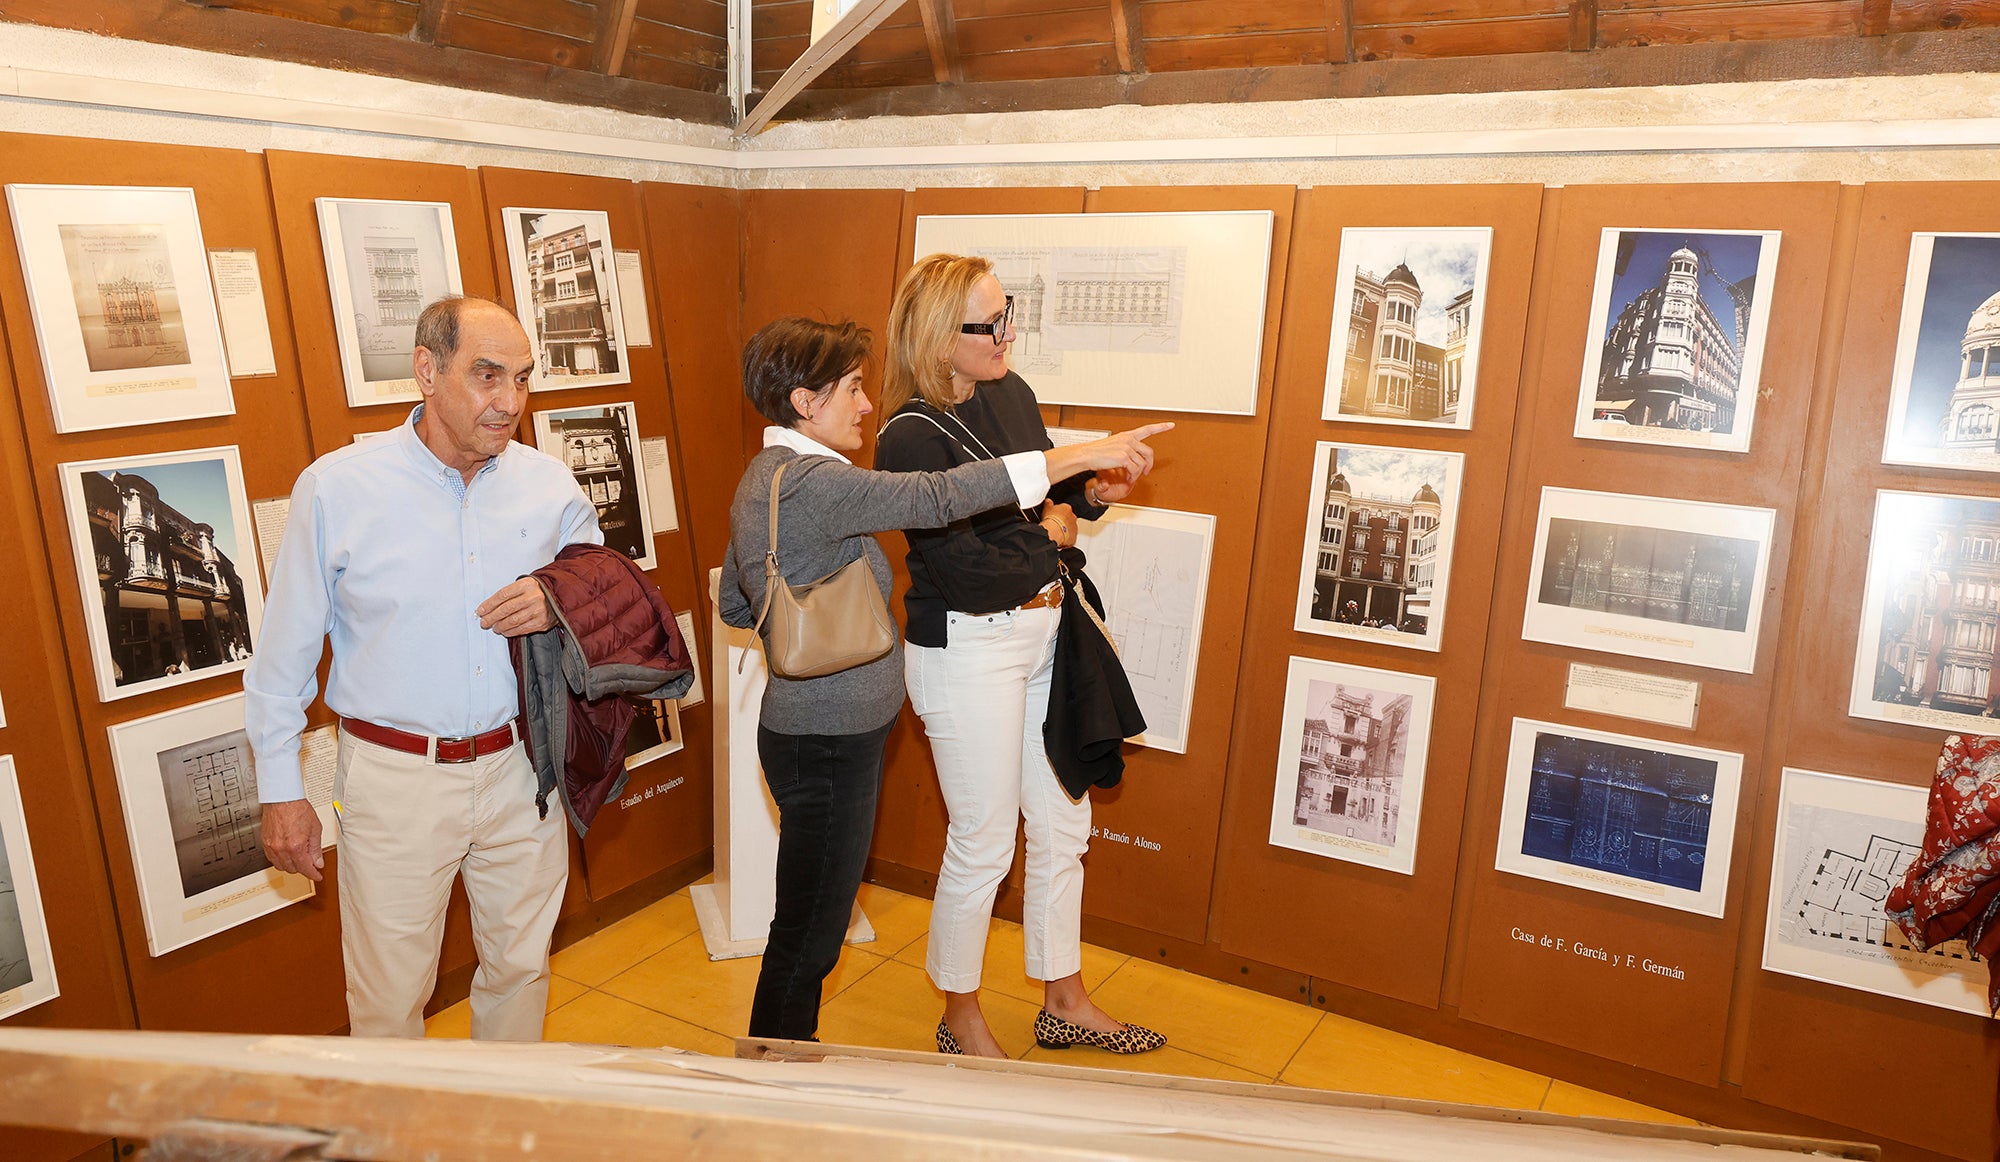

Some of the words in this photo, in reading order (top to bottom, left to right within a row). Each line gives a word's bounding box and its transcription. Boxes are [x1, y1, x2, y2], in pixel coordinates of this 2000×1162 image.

[974, 324, 987, 334] RH
[620, 793, 643, 810] Estudio
[644, 787, 654, 799] del
[656, 776, 684, 794] Arquitecto
[1090, 825, 1100, 837] de
[1103, 828, 1130, 844] Ramón
[1133, 836, 1162, 851] Alonso
[1511, 927, 1535, 944] Casa
[1541, 934, 1553, 948] de
[1556, 938, 1568, 952] F.
[1573, 942, 1607, 961] García
[1612, 955, 1620, 967] y
[1626, 955, 1636, 968] F.
[1642, 958, 1685, 980] Germán
